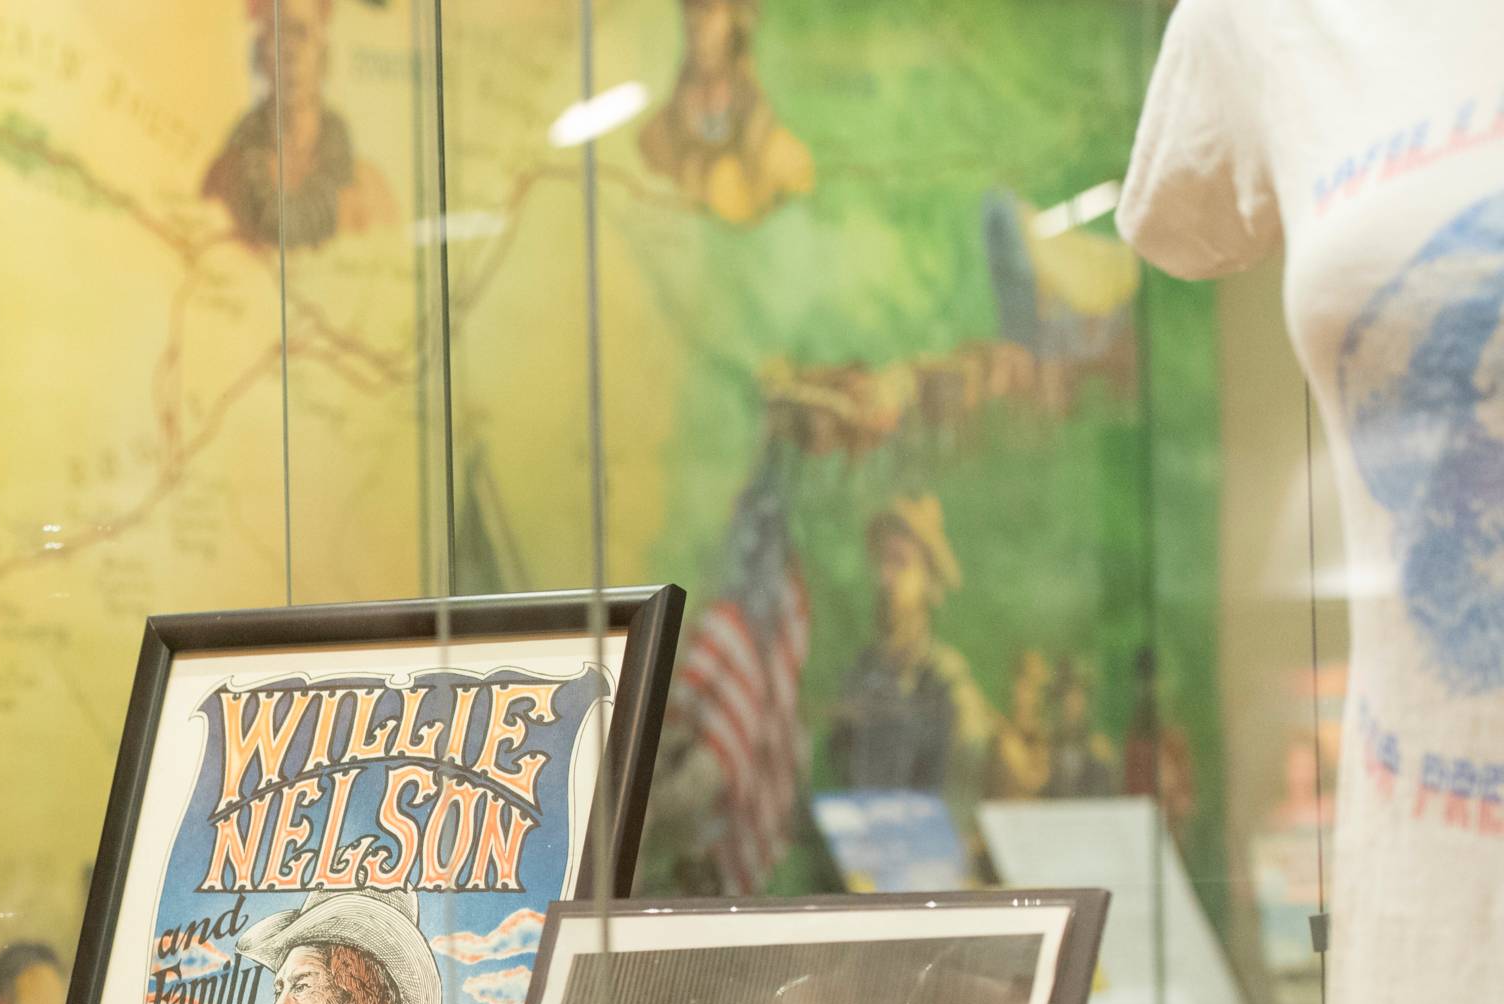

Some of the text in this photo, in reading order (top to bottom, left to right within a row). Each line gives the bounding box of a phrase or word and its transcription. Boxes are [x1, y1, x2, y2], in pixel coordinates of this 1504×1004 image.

[212, 681, 564, 818] WILLIE
[197, 765, 540, 892] NELSON
[157, 894, 249, 959] and
